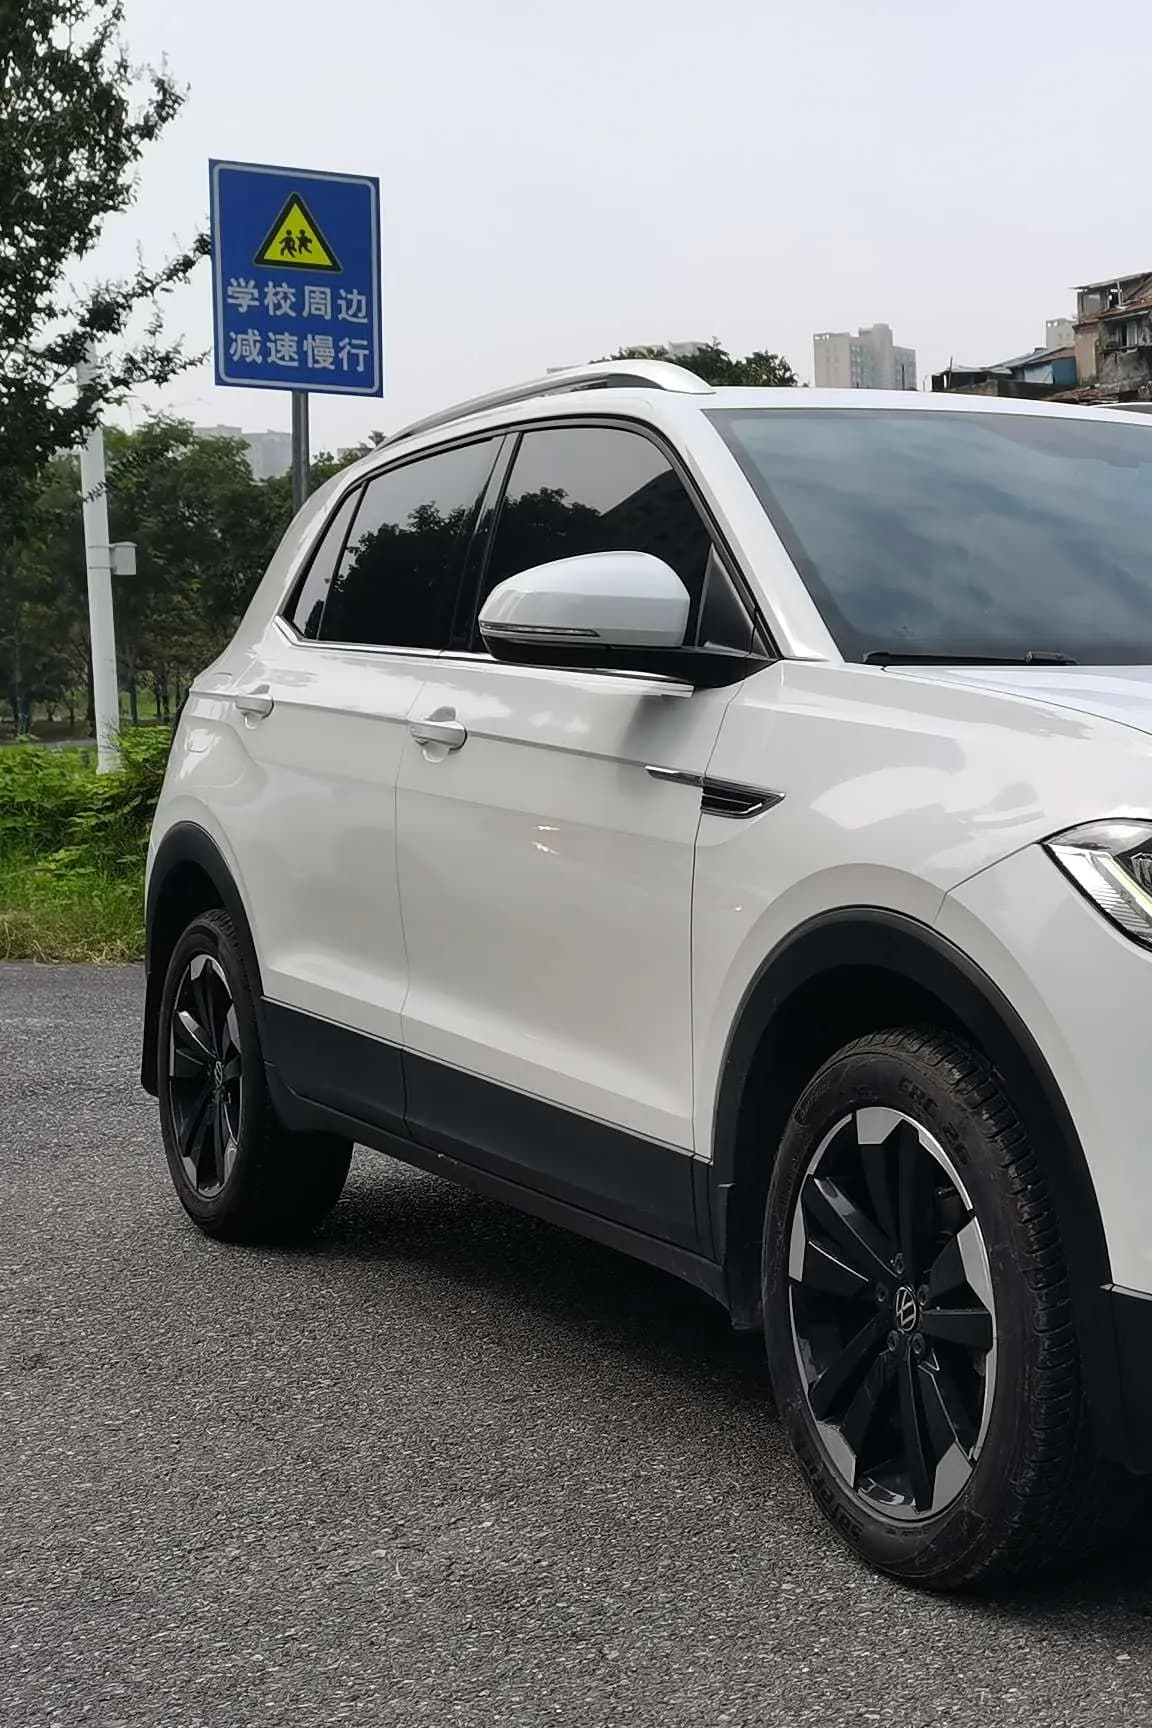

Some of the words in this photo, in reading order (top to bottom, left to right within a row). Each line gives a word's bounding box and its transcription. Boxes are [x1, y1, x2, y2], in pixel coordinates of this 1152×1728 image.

[227, 277, 369, 323] 学校周边
[229, 328, 370, 372] 减速慢行
